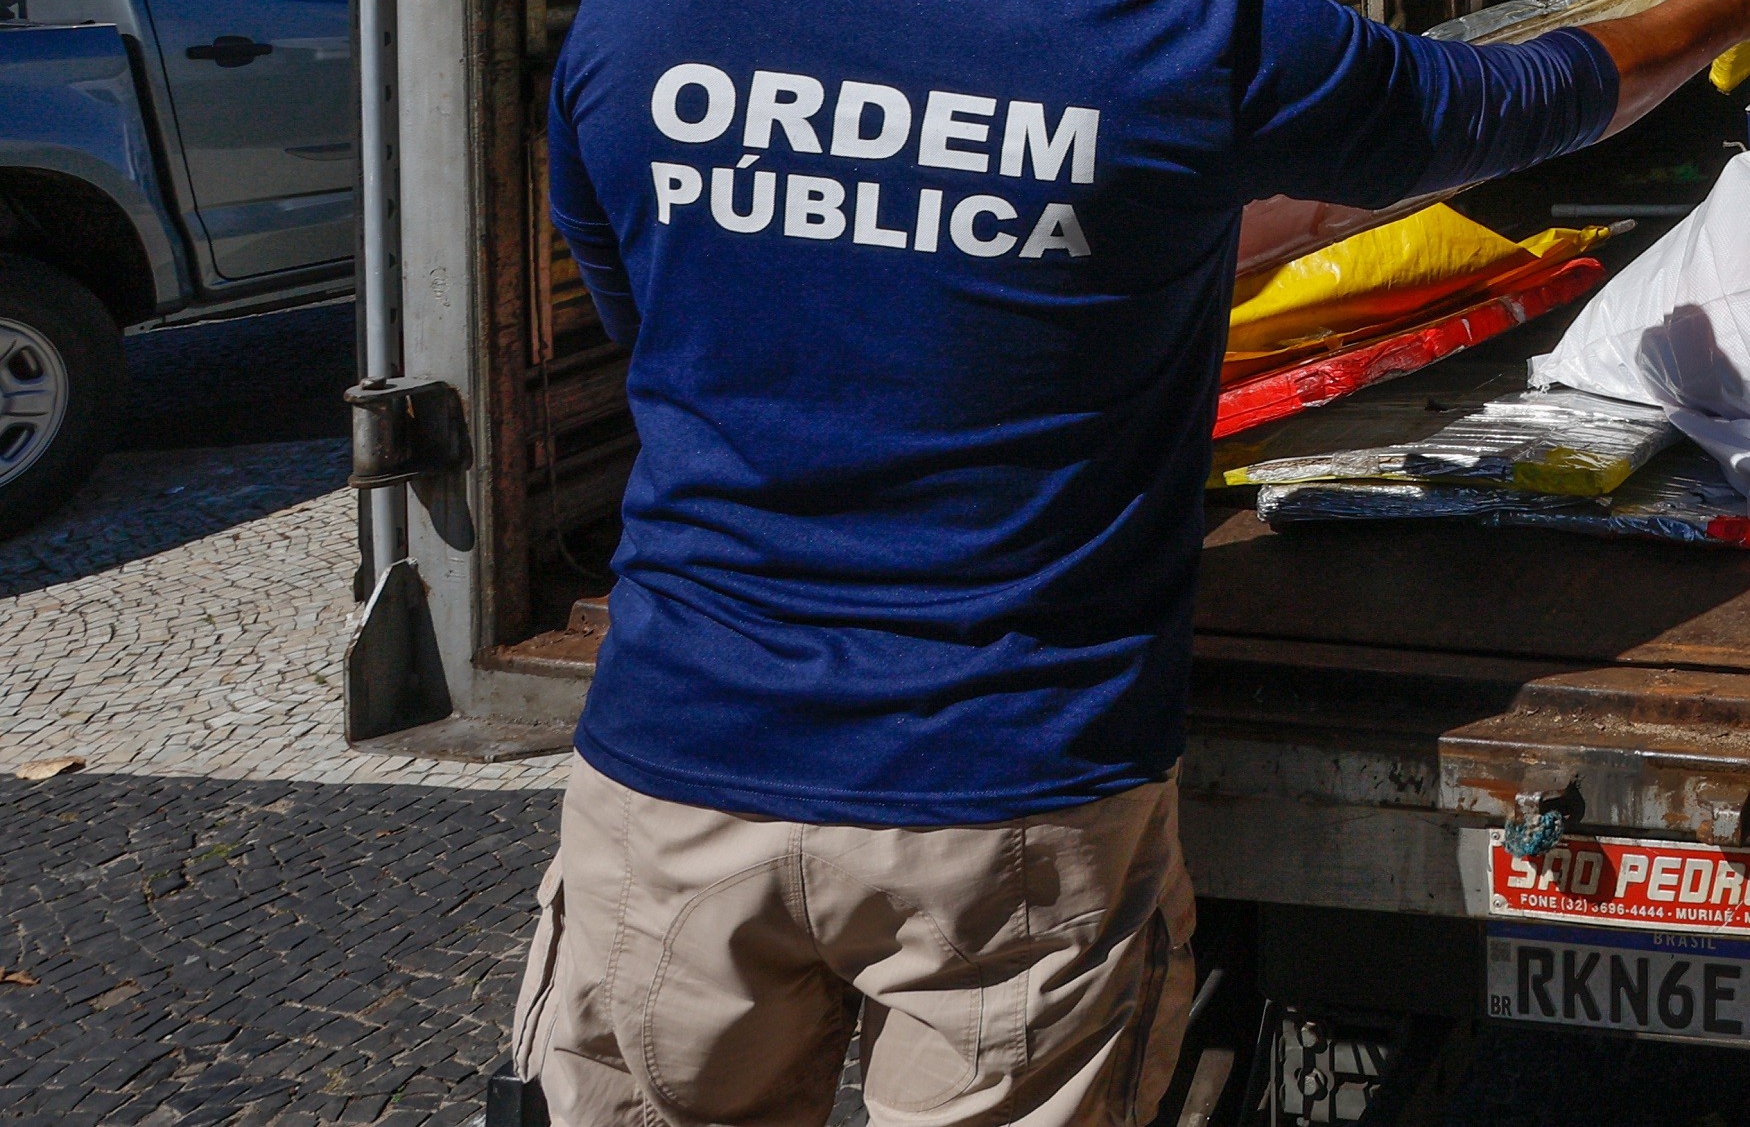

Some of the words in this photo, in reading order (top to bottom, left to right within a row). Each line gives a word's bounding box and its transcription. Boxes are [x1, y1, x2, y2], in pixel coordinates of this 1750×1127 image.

[651, 63, 1100, 184] ORDEM
[651, 154, 1091, 259] PÚBLICA
[1520, 893, 1557, 909] FONE
[1561, 898, 1588, 913] (32)
[1653, 932, 1717, 950] BRASIL
[1490, 994, 1512, 1016] BR
